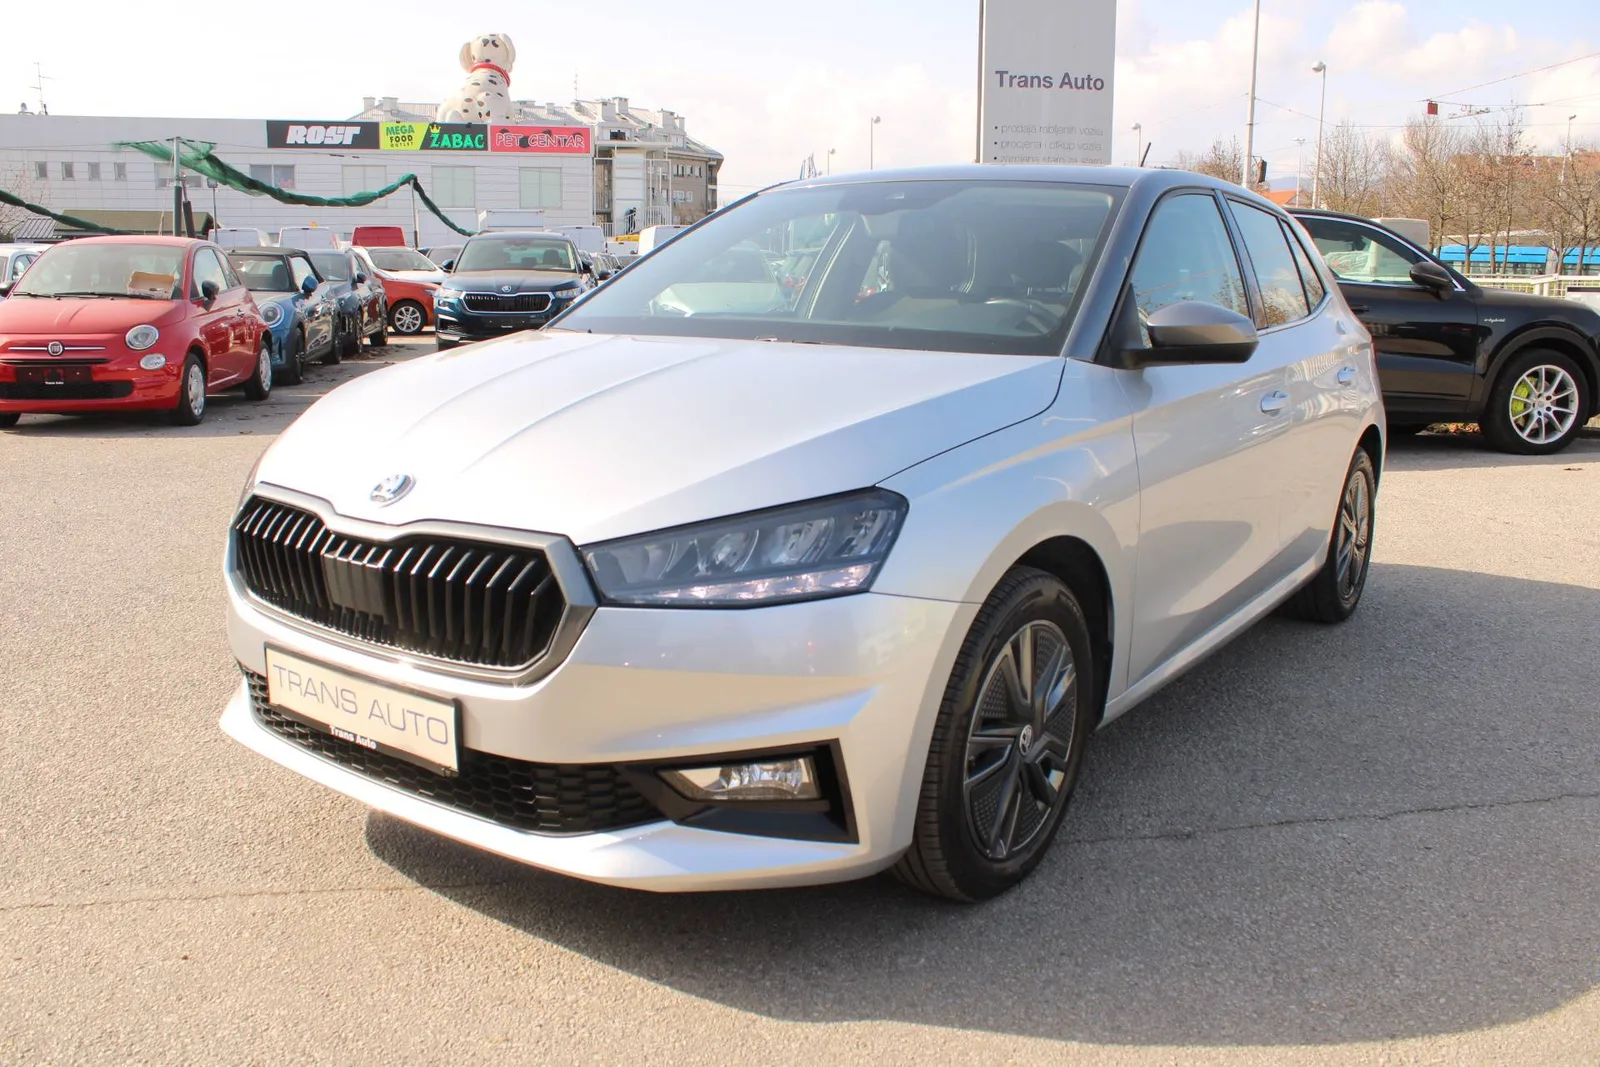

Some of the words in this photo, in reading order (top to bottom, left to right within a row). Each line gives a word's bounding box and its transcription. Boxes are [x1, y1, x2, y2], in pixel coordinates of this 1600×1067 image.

[995, 71, 1053, 89] Trans
[1059, 72, 1105, 91] Auto
[286, 125, 361, 145] ROST
[386, 125, 415, 136] MEGA
[1001, 125, 1037, 135] prodaja
[390, 135, 413, 144] FOOD
[495, 132, 523, 148] PET
[527, 133, 585, 148] CENTAR
[272, 664, 358, 715] TRANS
[368, 699, 449, 745] AUTO
[329, 725, 355, 742] Trans
[355, 733, 377, 750] Auto
